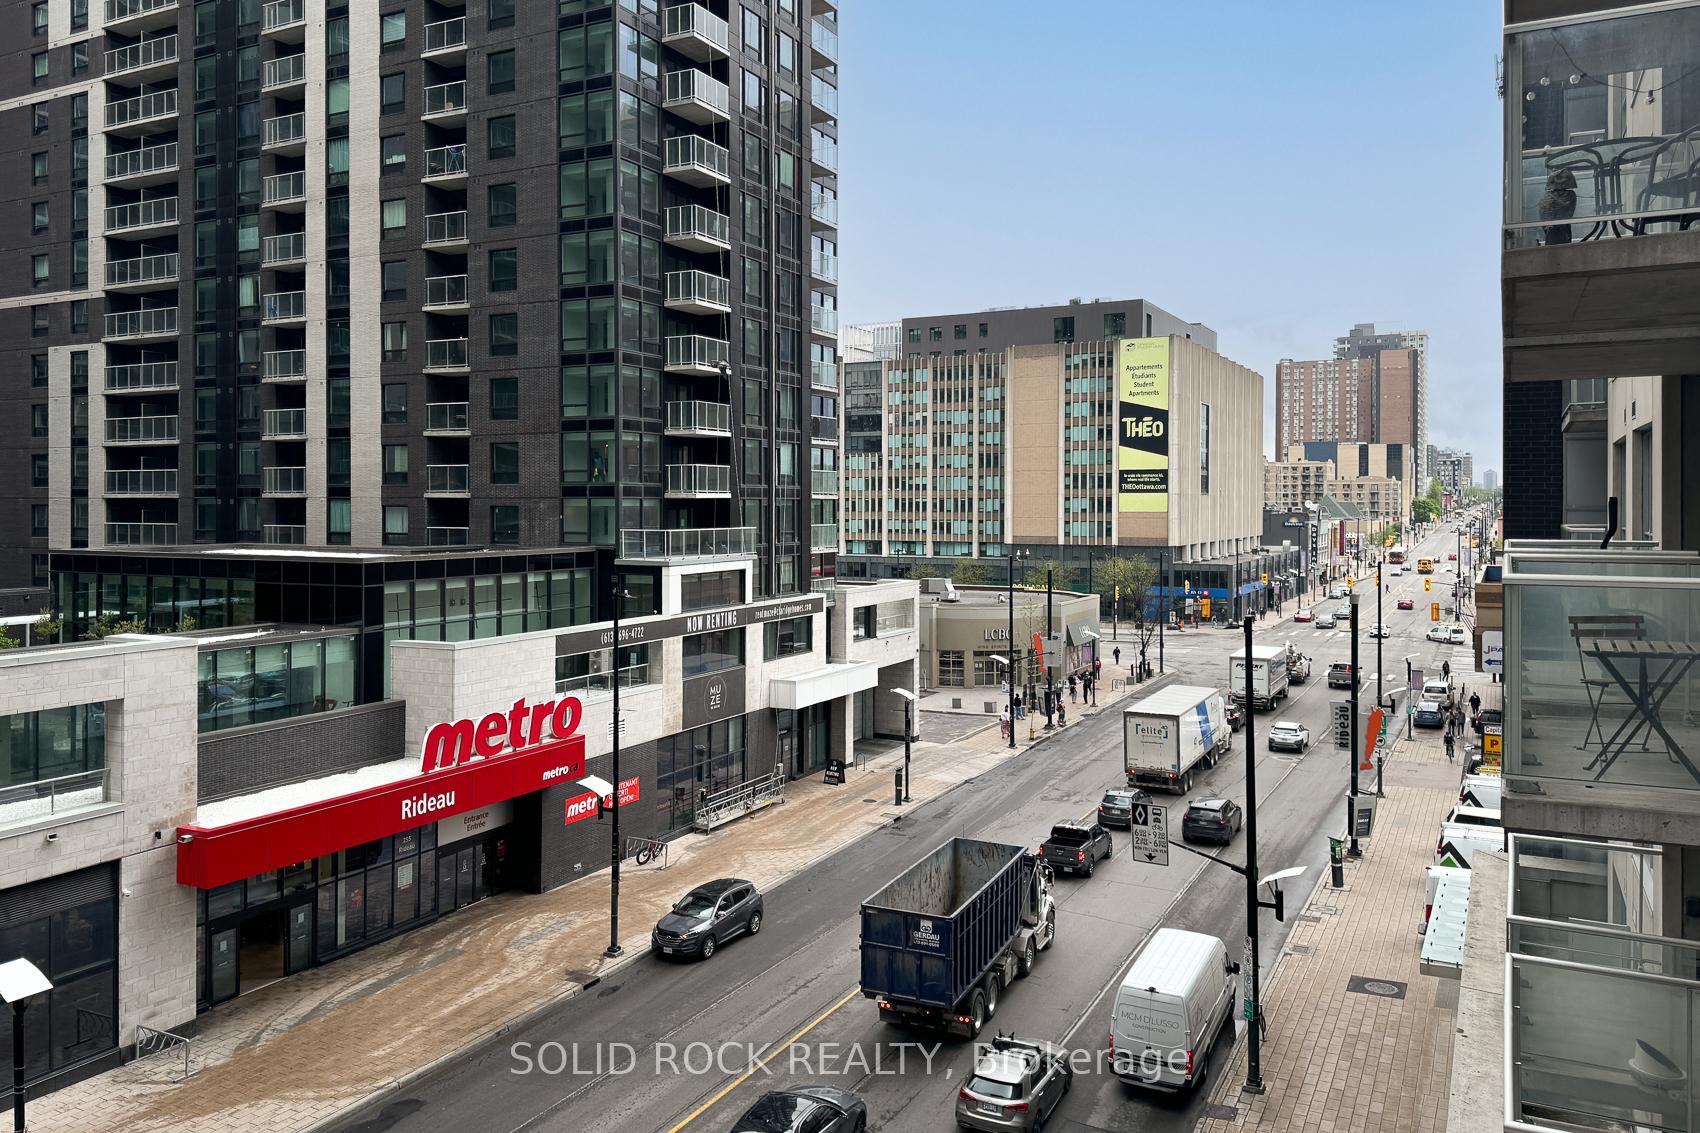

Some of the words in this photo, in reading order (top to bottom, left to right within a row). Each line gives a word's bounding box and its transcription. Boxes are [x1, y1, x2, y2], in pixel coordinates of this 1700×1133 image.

[1126, 363, 1163, 372] Appartements
[687, 616, 704, 633] NOW
[706, 610, 737, 629] RENTING
[600, 632, 614, 644] (613
[1235, 662, 1264, 670] PEKE
[709, 684, 722, 696] MU
[709, 694, 721, 705] ZE
[421, 696, 583, 773] metro
[1490, 739, 1499, 748] P
[542, 761, 579, 781] metro.ca
[401, 790, 456, 820] Rideau
[566, 796, 598, 818] metr
[463, 811, 489, 825] Entrance
[466, 820, 486, 832] Entrée
[913, 930, 940, 941] GERDAU
